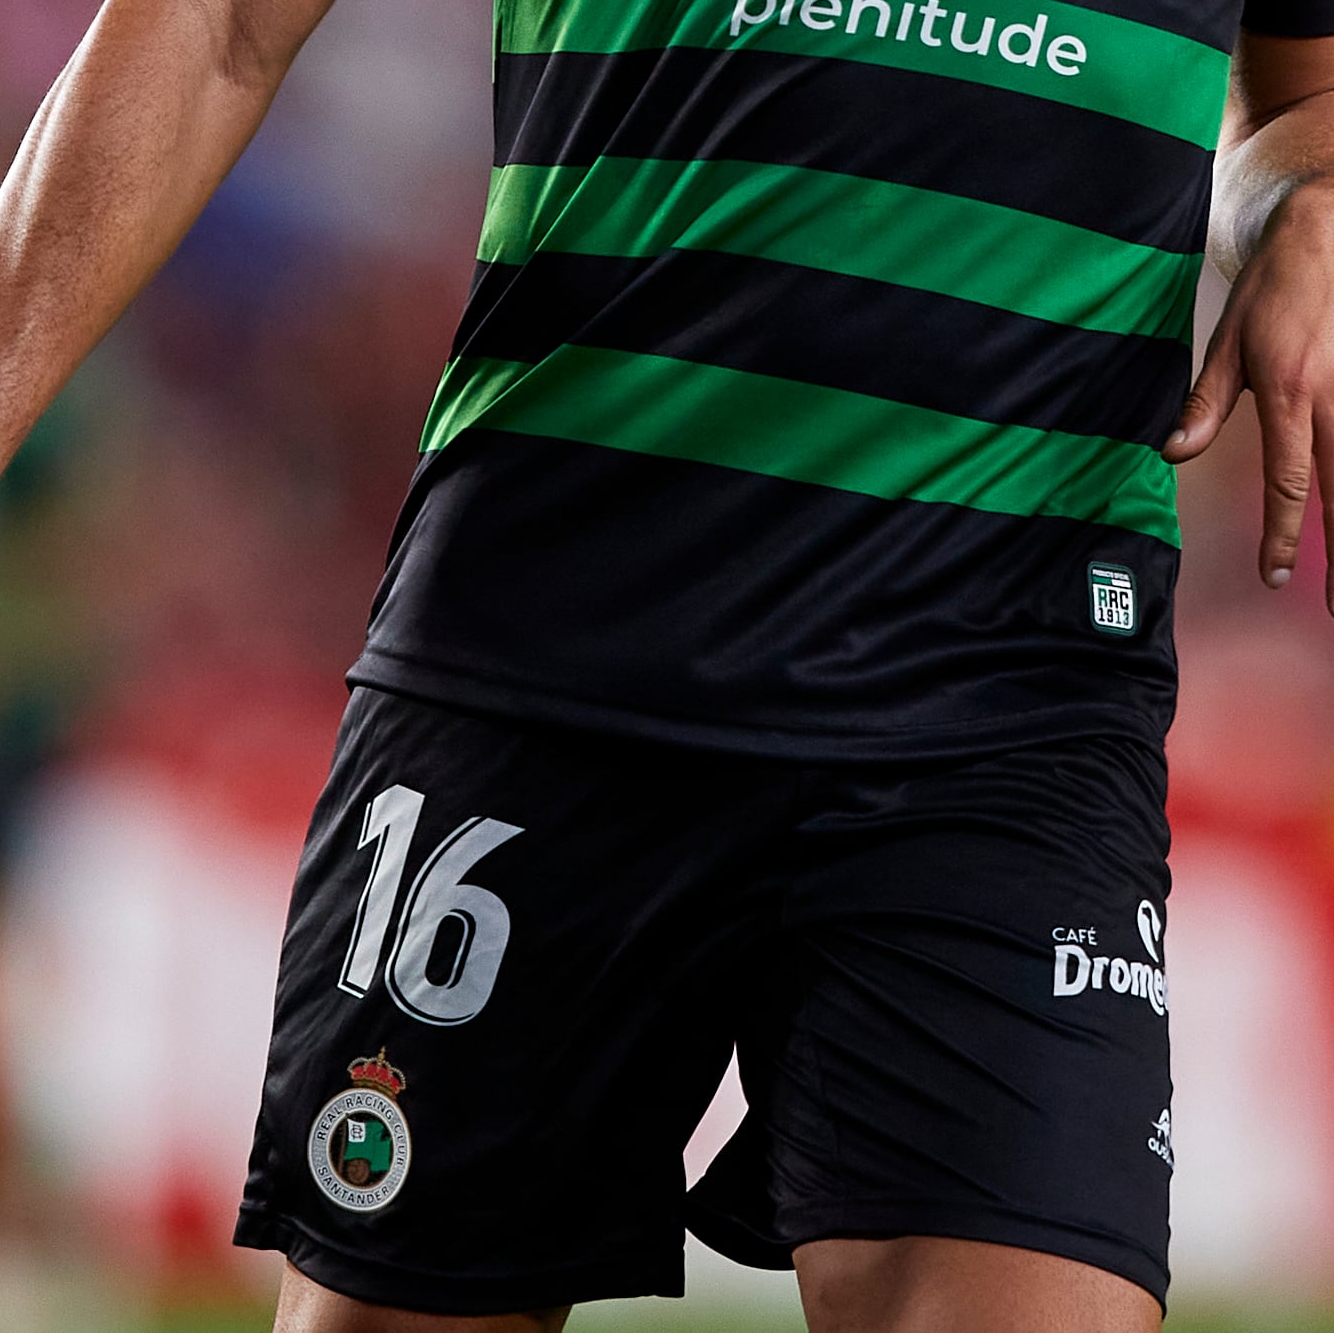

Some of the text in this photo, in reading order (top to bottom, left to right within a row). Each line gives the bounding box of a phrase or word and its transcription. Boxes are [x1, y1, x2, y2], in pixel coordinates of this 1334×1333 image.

[1098, 588, 1129, 610] RRC
[1098, 607, 1129, 626] 1913
[337, 784, 526, 1027] 16
[1052, 926, 1098, 946] CAFÉ
[317, 1096, 406, 1166] REAL RACING CLUB
[318, 1166, 389, 1205] SANTANDER
